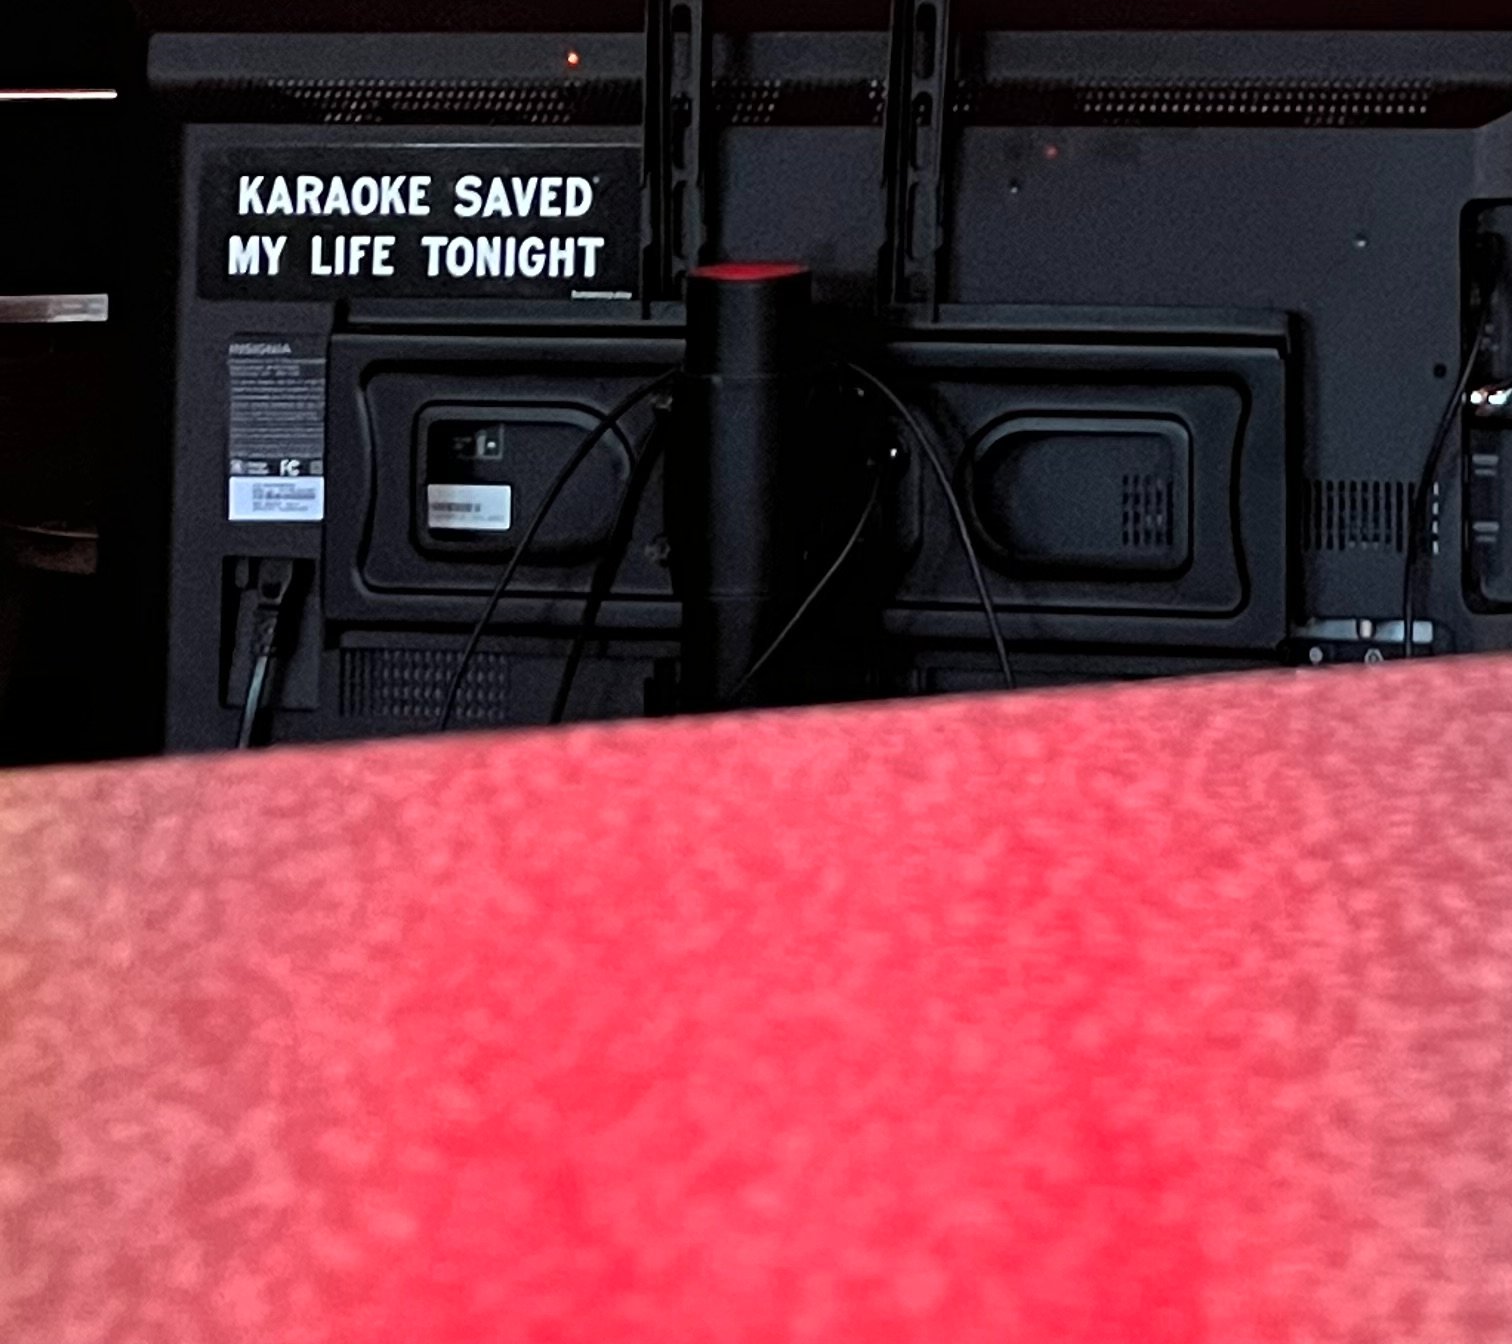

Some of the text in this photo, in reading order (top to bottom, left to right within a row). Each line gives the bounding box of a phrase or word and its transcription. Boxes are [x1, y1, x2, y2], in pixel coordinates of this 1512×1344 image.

[238, 175, 593, 218] KARAOKE SAVED
[228, 234, 605, 279] MY LIFE TONIGHT
